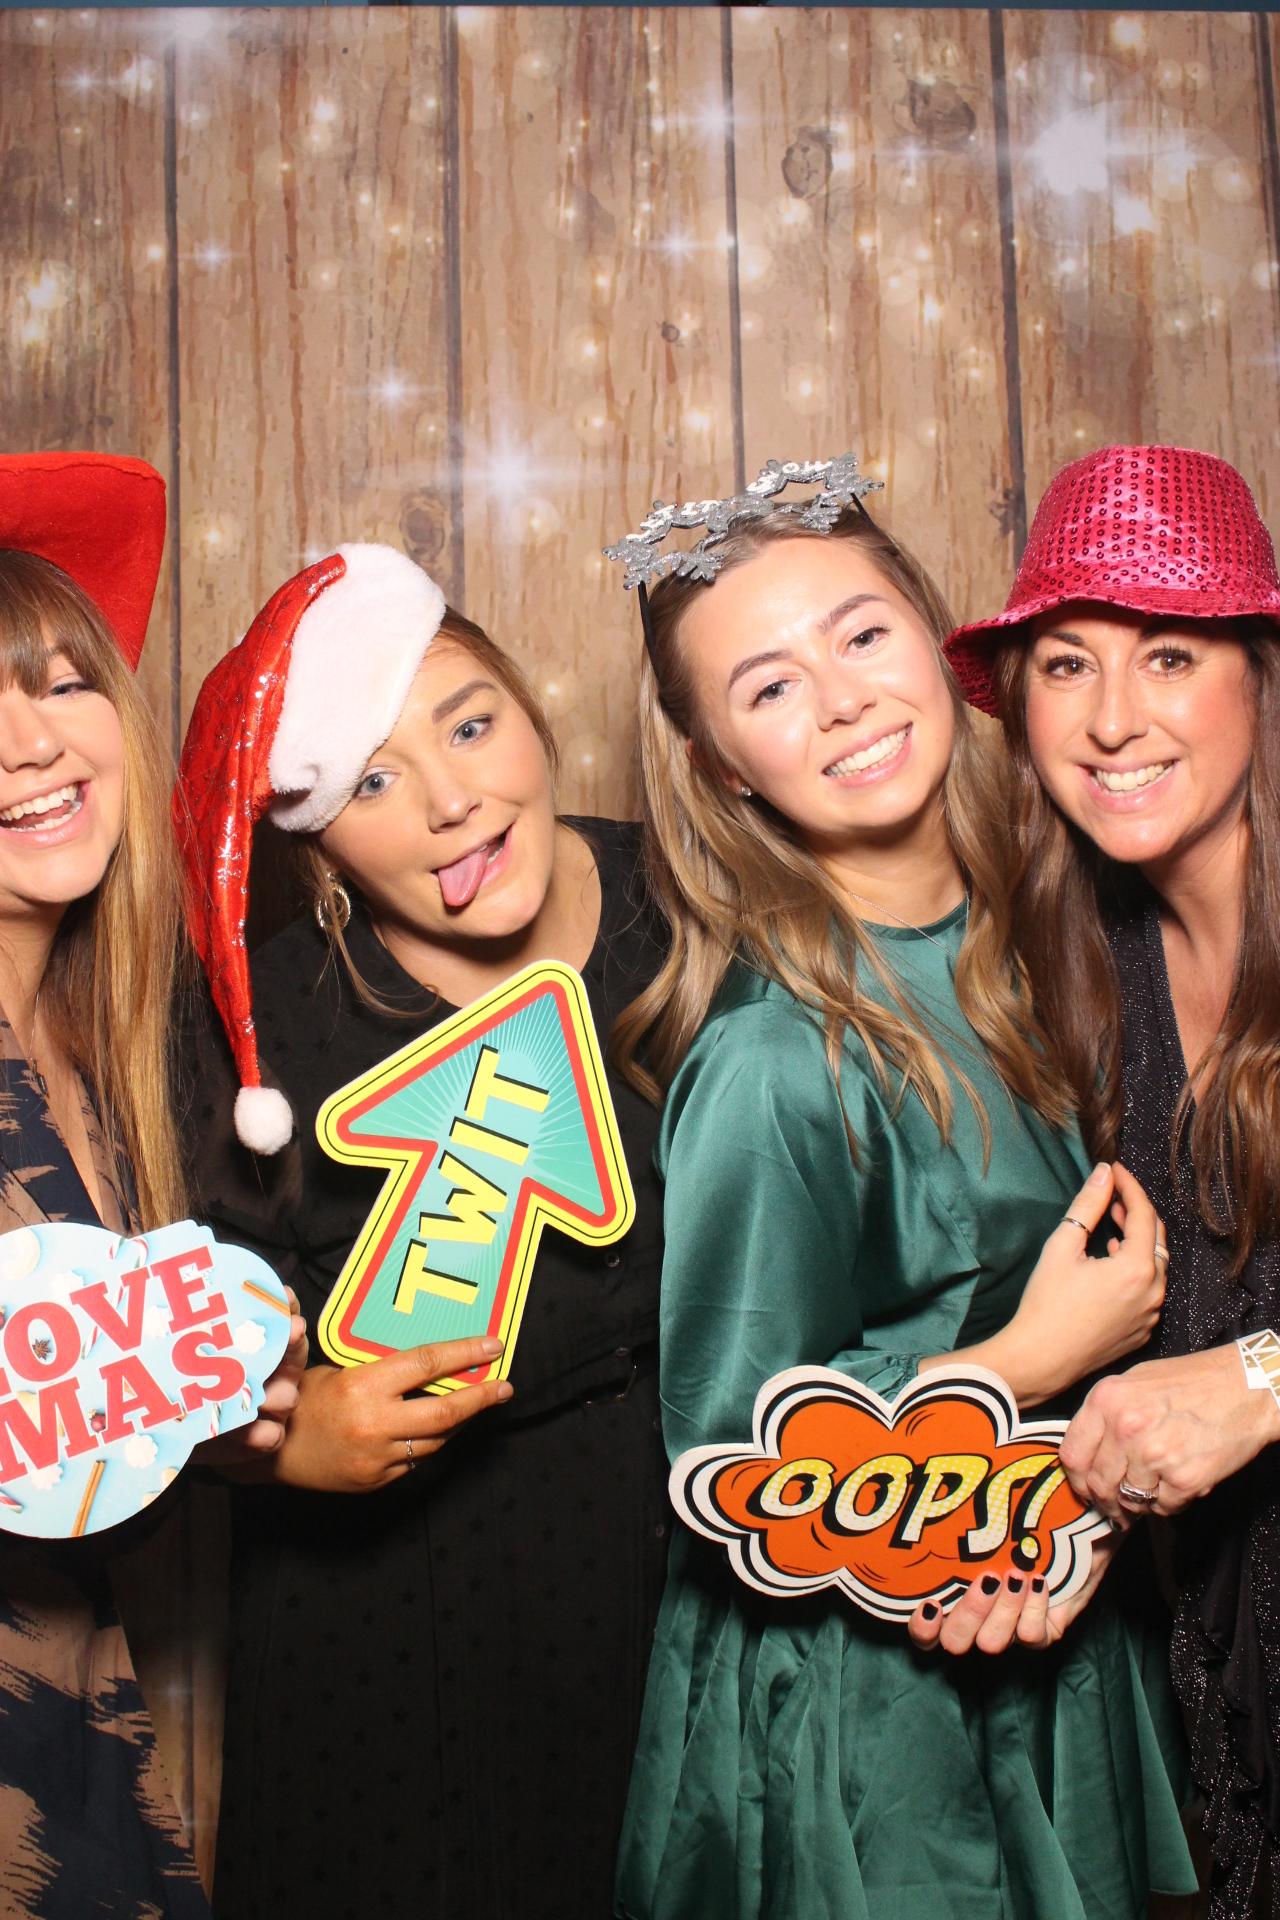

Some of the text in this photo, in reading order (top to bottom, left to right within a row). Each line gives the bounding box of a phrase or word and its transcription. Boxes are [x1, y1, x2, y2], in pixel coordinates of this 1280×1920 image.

[393, 1044, 550, 1315] TWIT
[0, 1246, 230, 1396] OVE
[749, 1453, 1069, 1568] OOPS!
